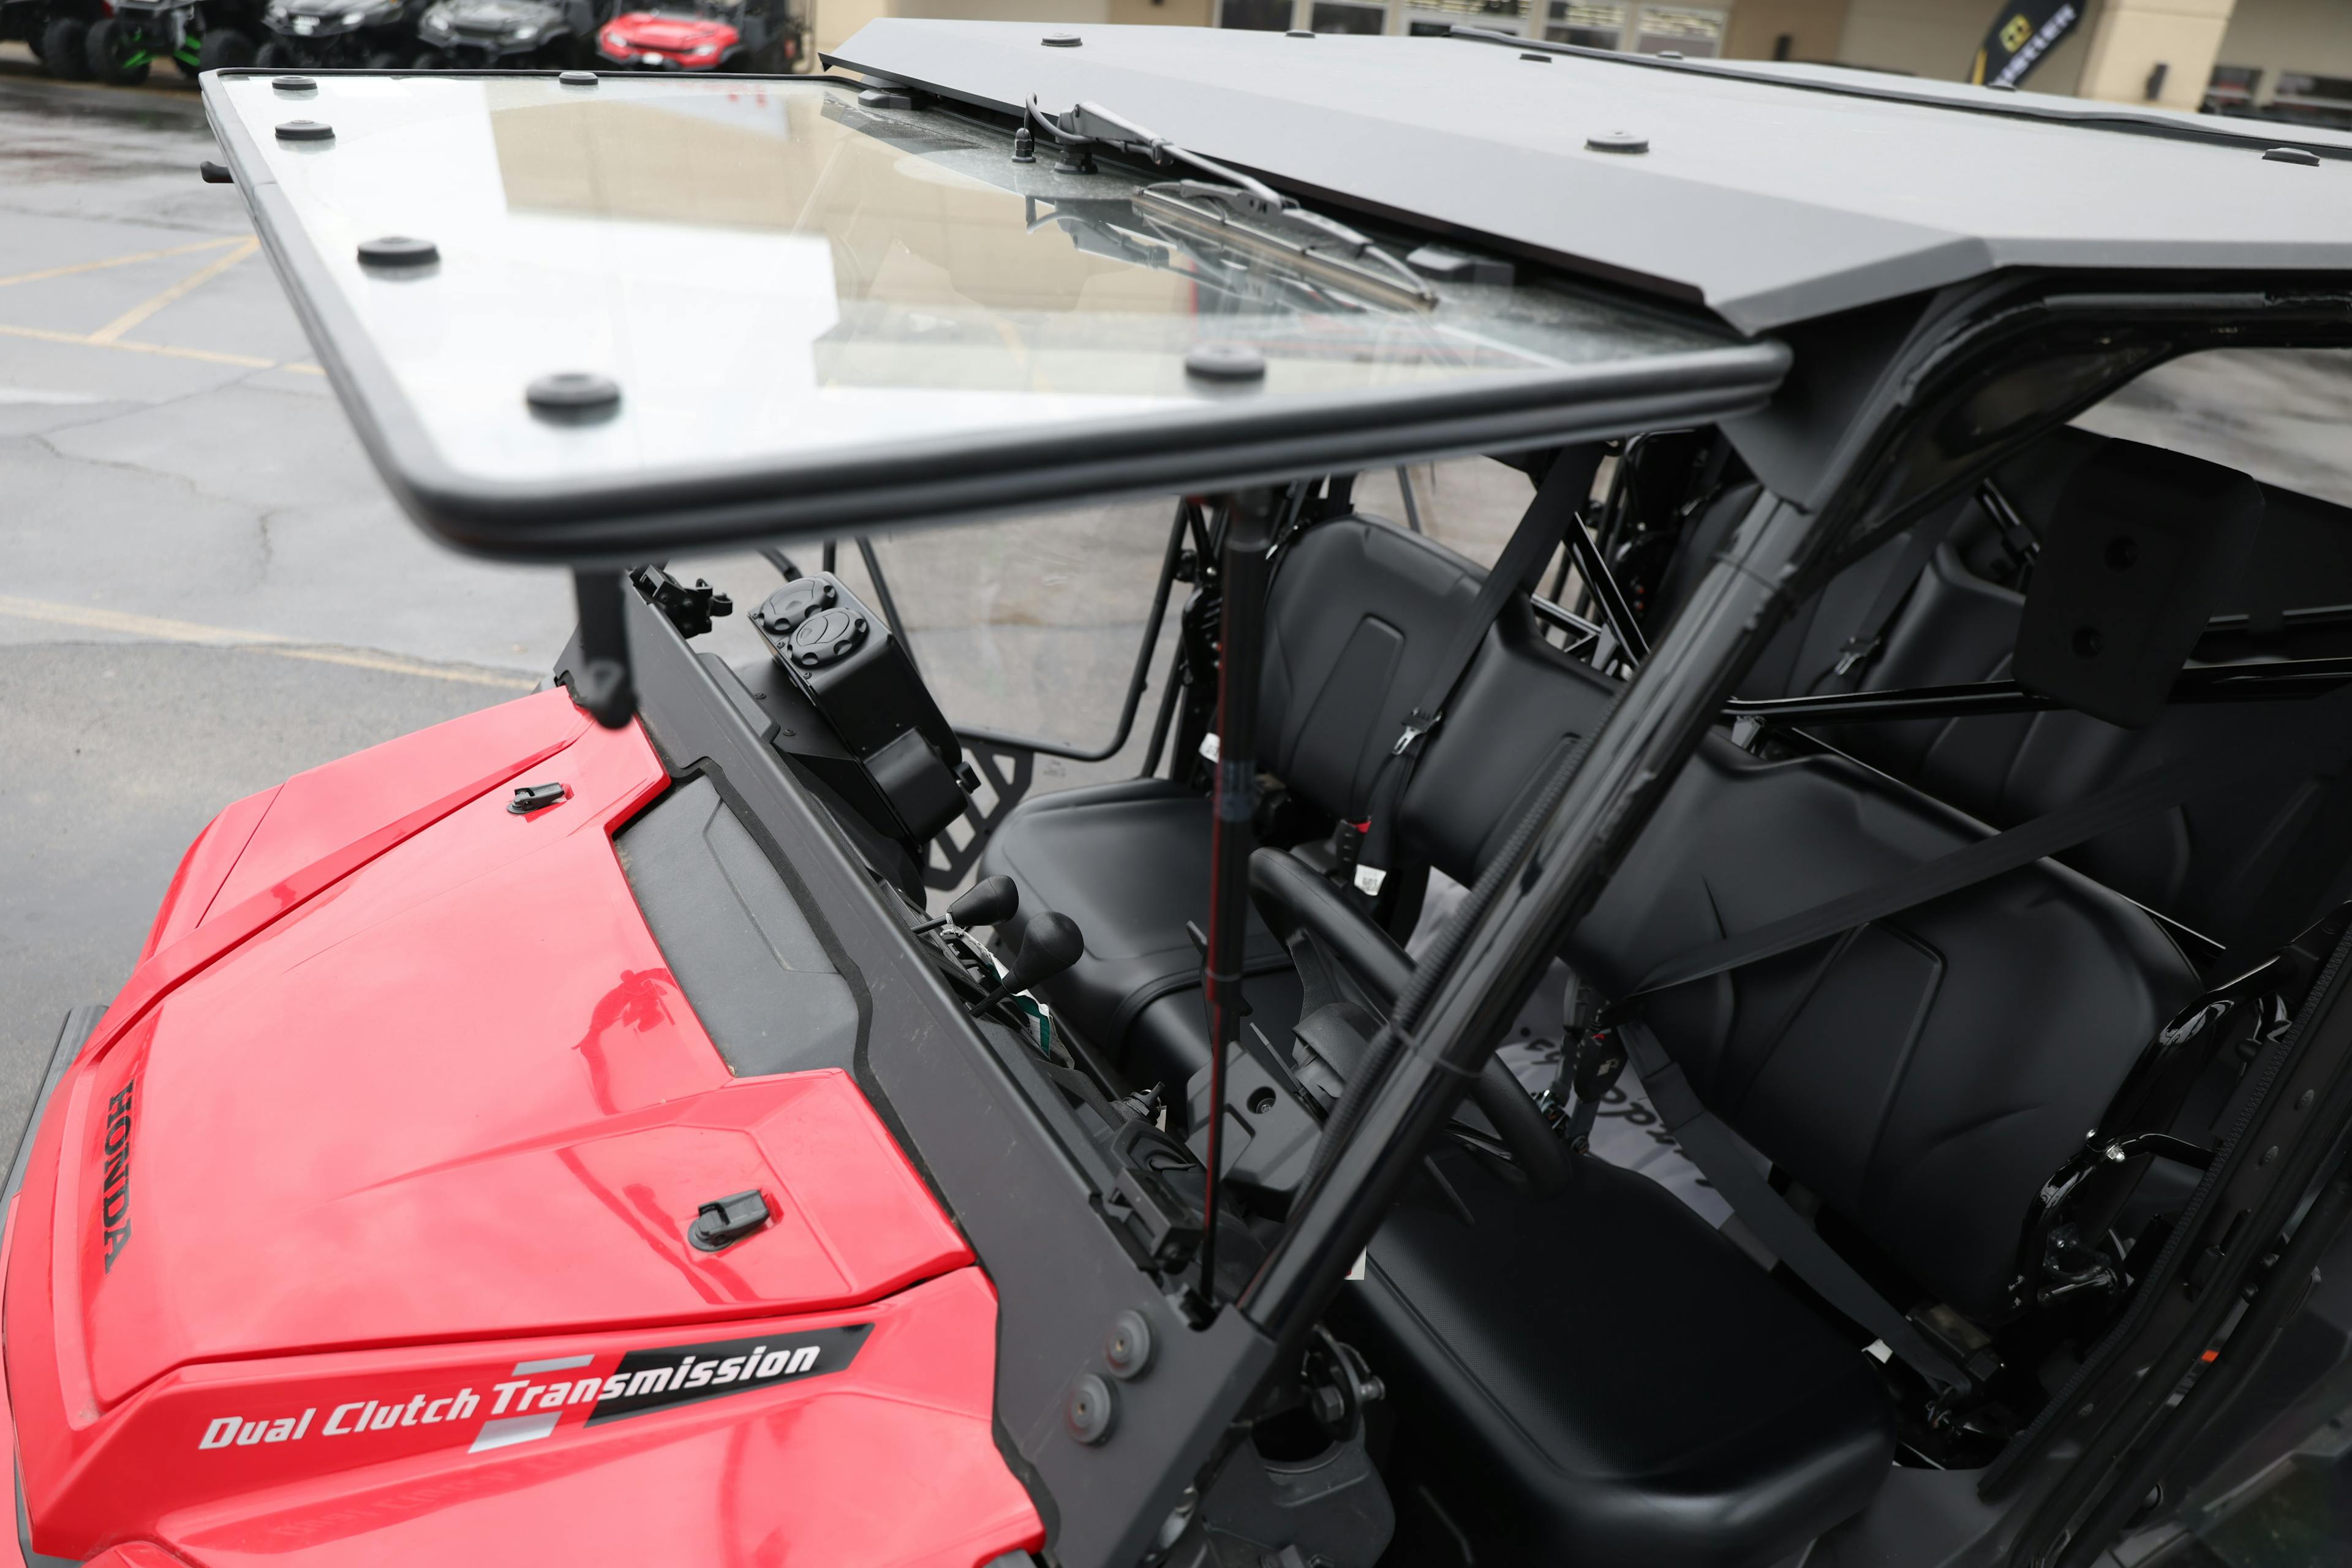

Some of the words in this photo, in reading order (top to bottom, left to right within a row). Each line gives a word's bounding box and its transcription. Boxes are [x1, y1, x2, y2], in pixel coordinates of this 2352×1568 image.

[104, 1078, 134, 1275] HONDA
[198, 1408, 317, 1450] Dual
[322, 1387, 481, 1436] Clutch
[492, 1346, 821, 1416] Transmission
